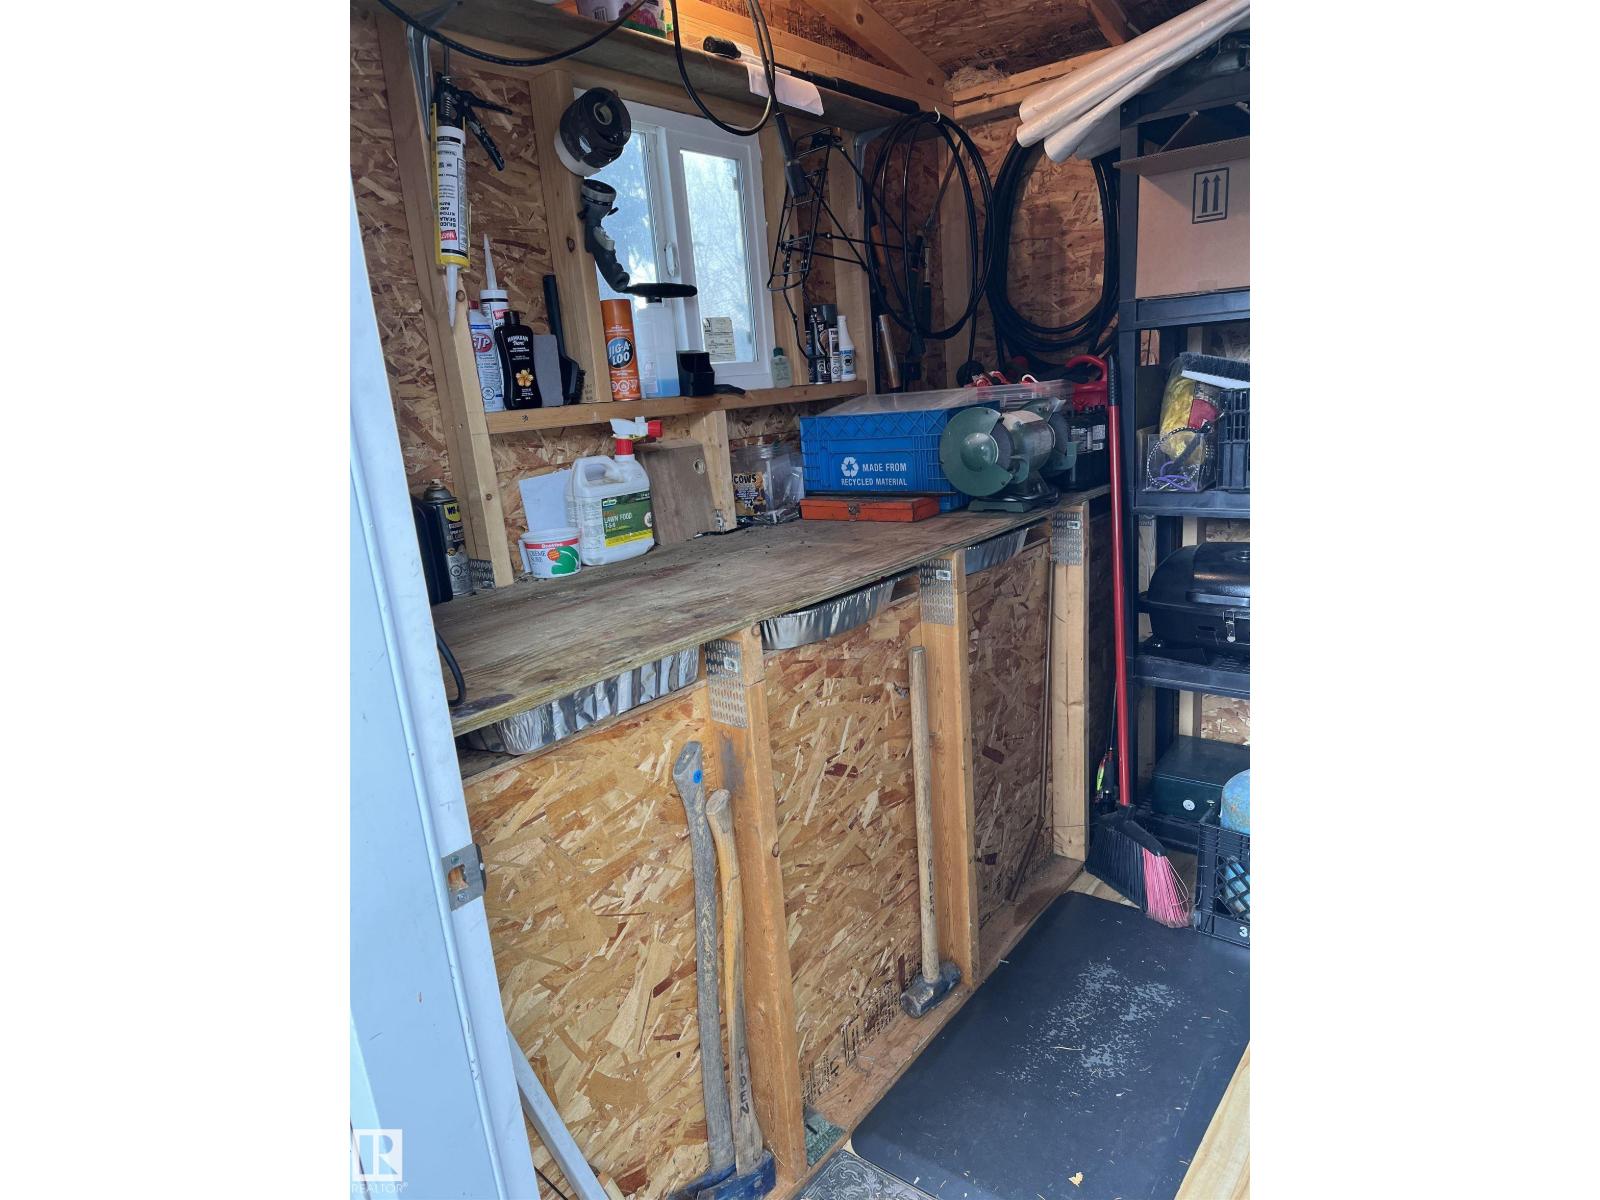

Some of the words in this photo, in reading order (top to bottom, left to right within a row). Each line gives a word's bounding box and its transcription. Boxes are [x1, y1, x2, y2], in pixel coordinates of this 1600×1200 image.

[613, 352, 630, 365] LOO
[862, 463, 883, 472] MADE
[885, 463, 907, 472] FROM
[734, 474, 756, 484] COWS
[841, 478, 874, 486] RECYCLED
[875, 478, 908, 486] MATERIAL
[620, 512, 633, 521] FOOD
[1239, 926, 1248, 938] 3
